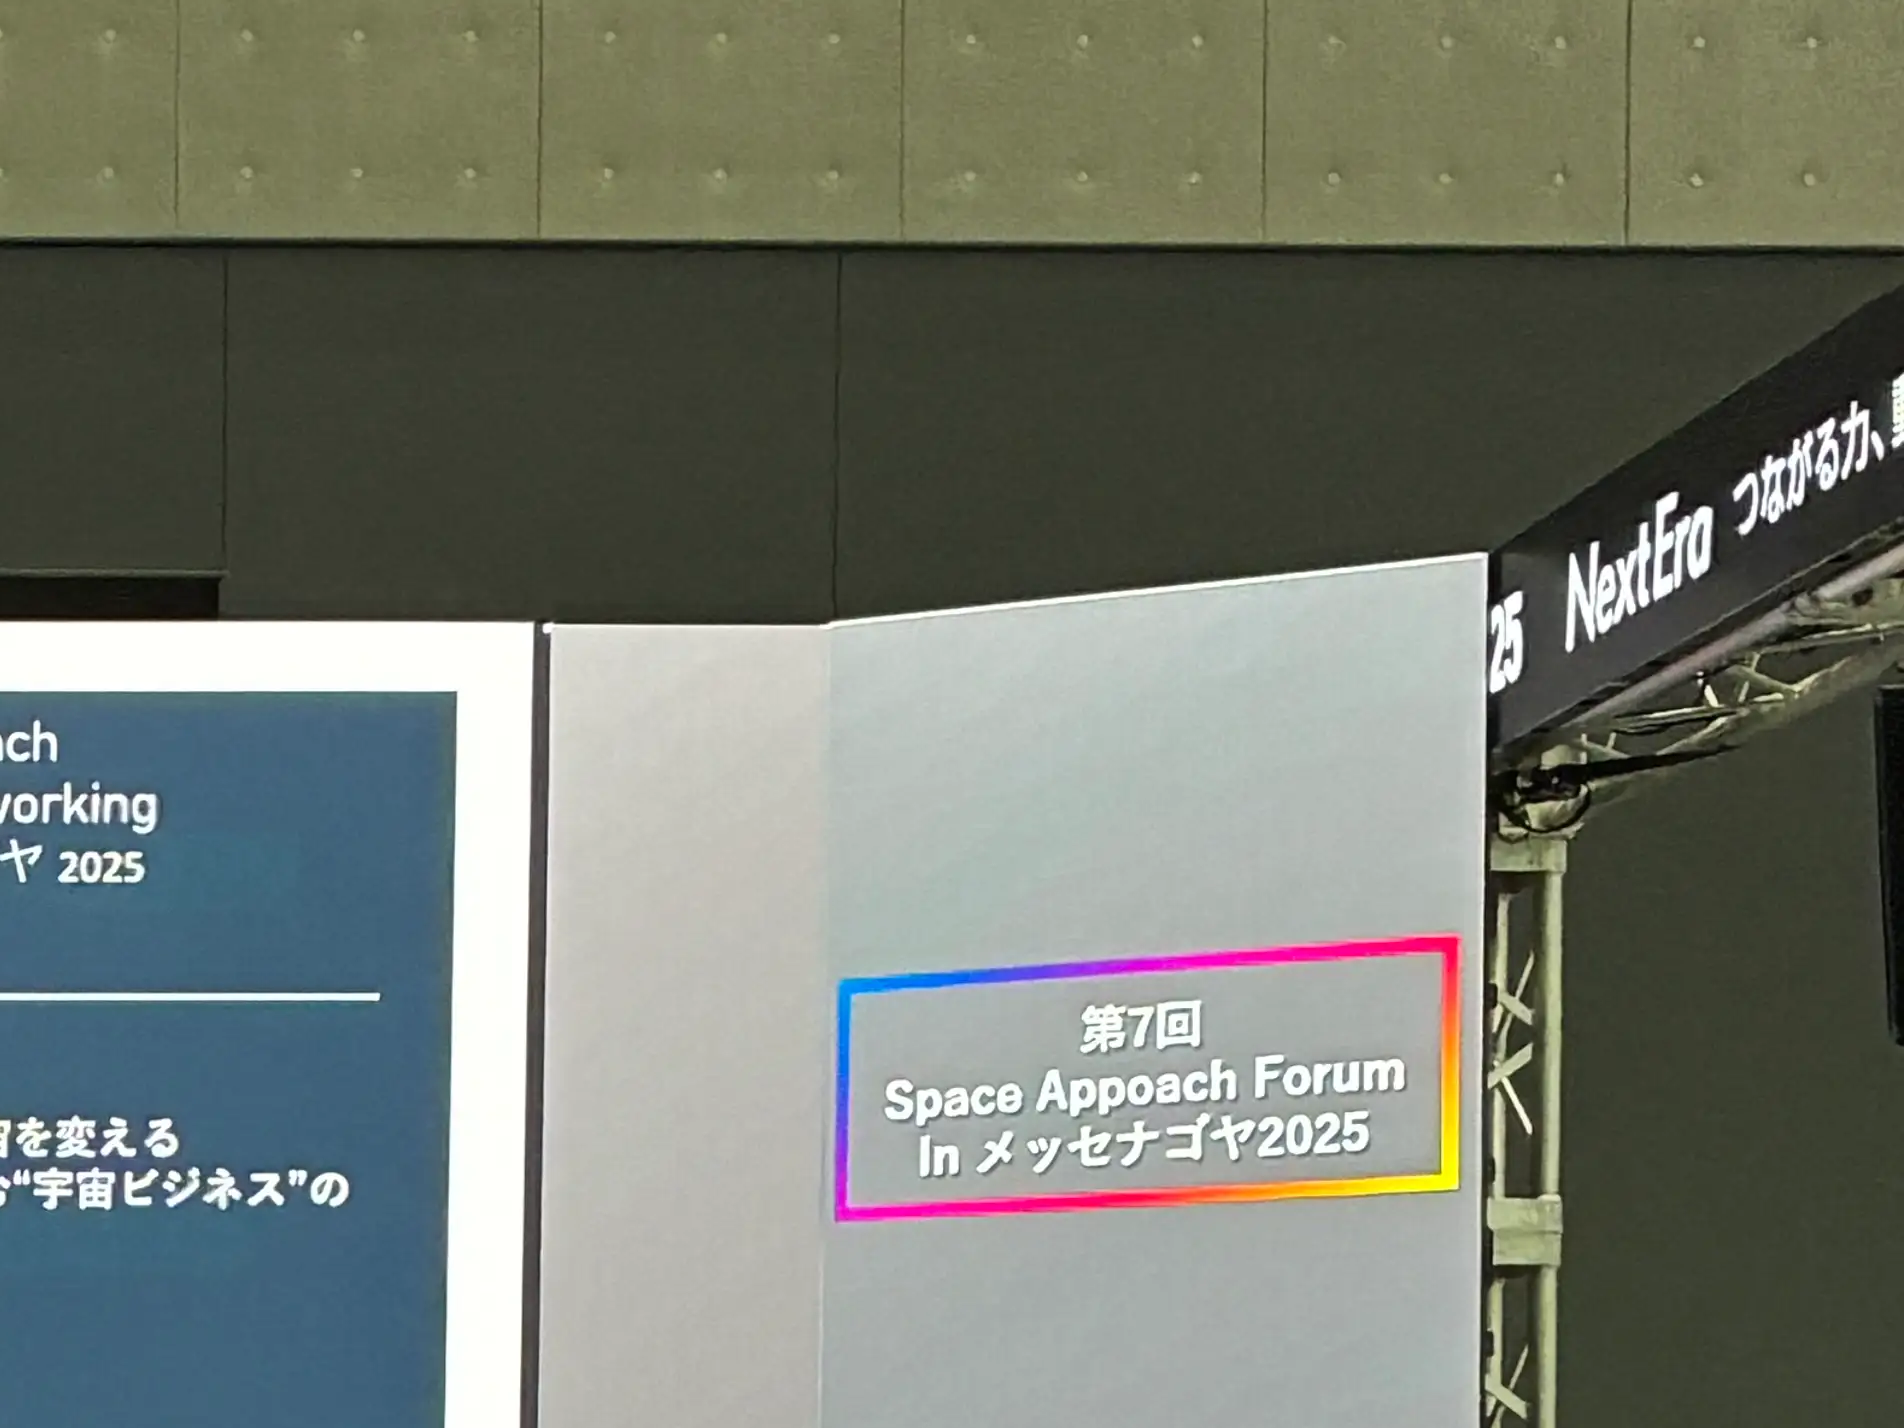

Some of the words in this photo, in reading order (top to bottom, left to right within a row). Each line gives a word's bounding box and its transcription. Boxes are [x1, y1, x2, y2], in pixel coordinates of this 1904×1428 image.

[1566, 492, 1713, 652] NextEra
[57, 850, 146, 884] 2025
[1080, 1000, 1202, 1054] 第7回
[884, 1079, 1023, 1126] Space
[1035, 1059, 1238, 1112] Appoach
[1254, 1054, 1406, 1099] Forum
[918, 1134, 960, 1178] In
[975, 1111, 1370, 1175] メッセナゴヤ2025
